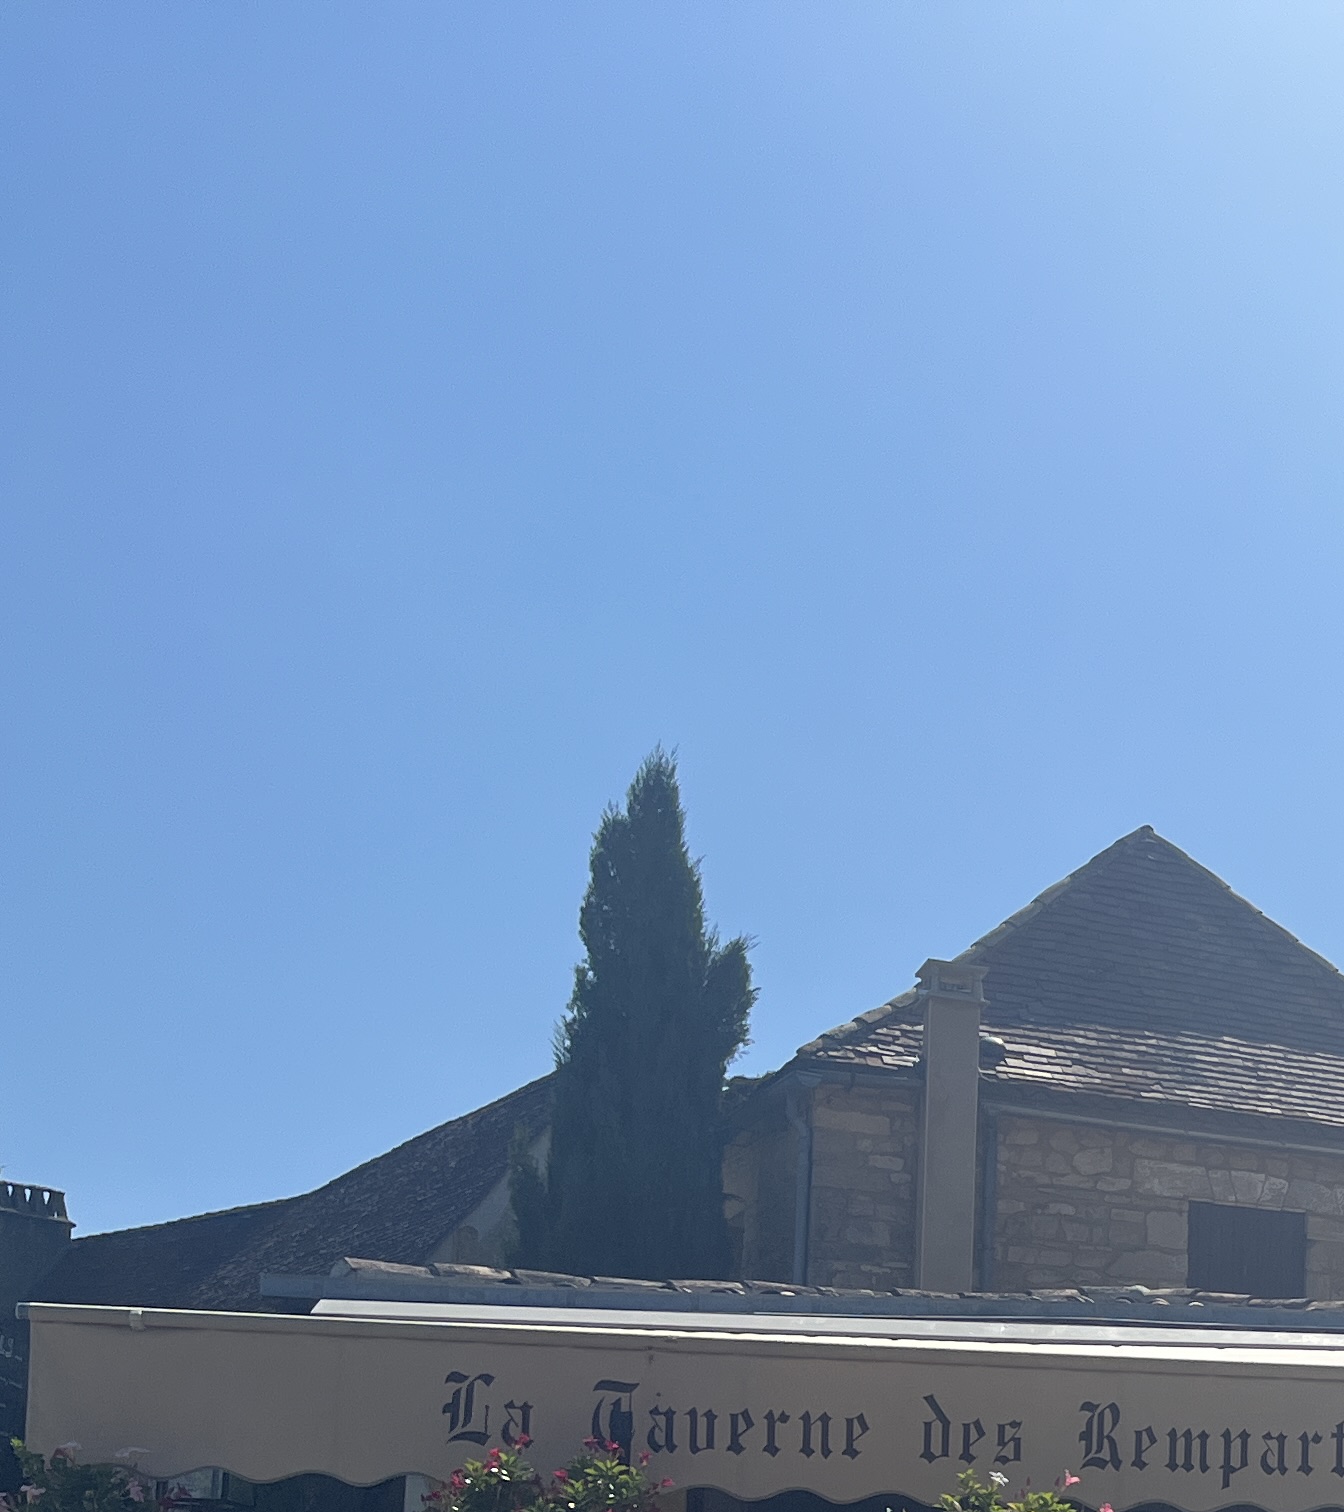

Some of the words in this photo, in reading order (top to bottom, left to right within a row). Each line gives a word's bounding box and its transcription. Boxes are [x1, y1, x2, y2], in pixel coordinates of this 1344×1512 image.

[442, 1371, 534, 1450] La
[592, 1379, 871, 1461] Taverne
[919, 1394, 1023, 1466] des
